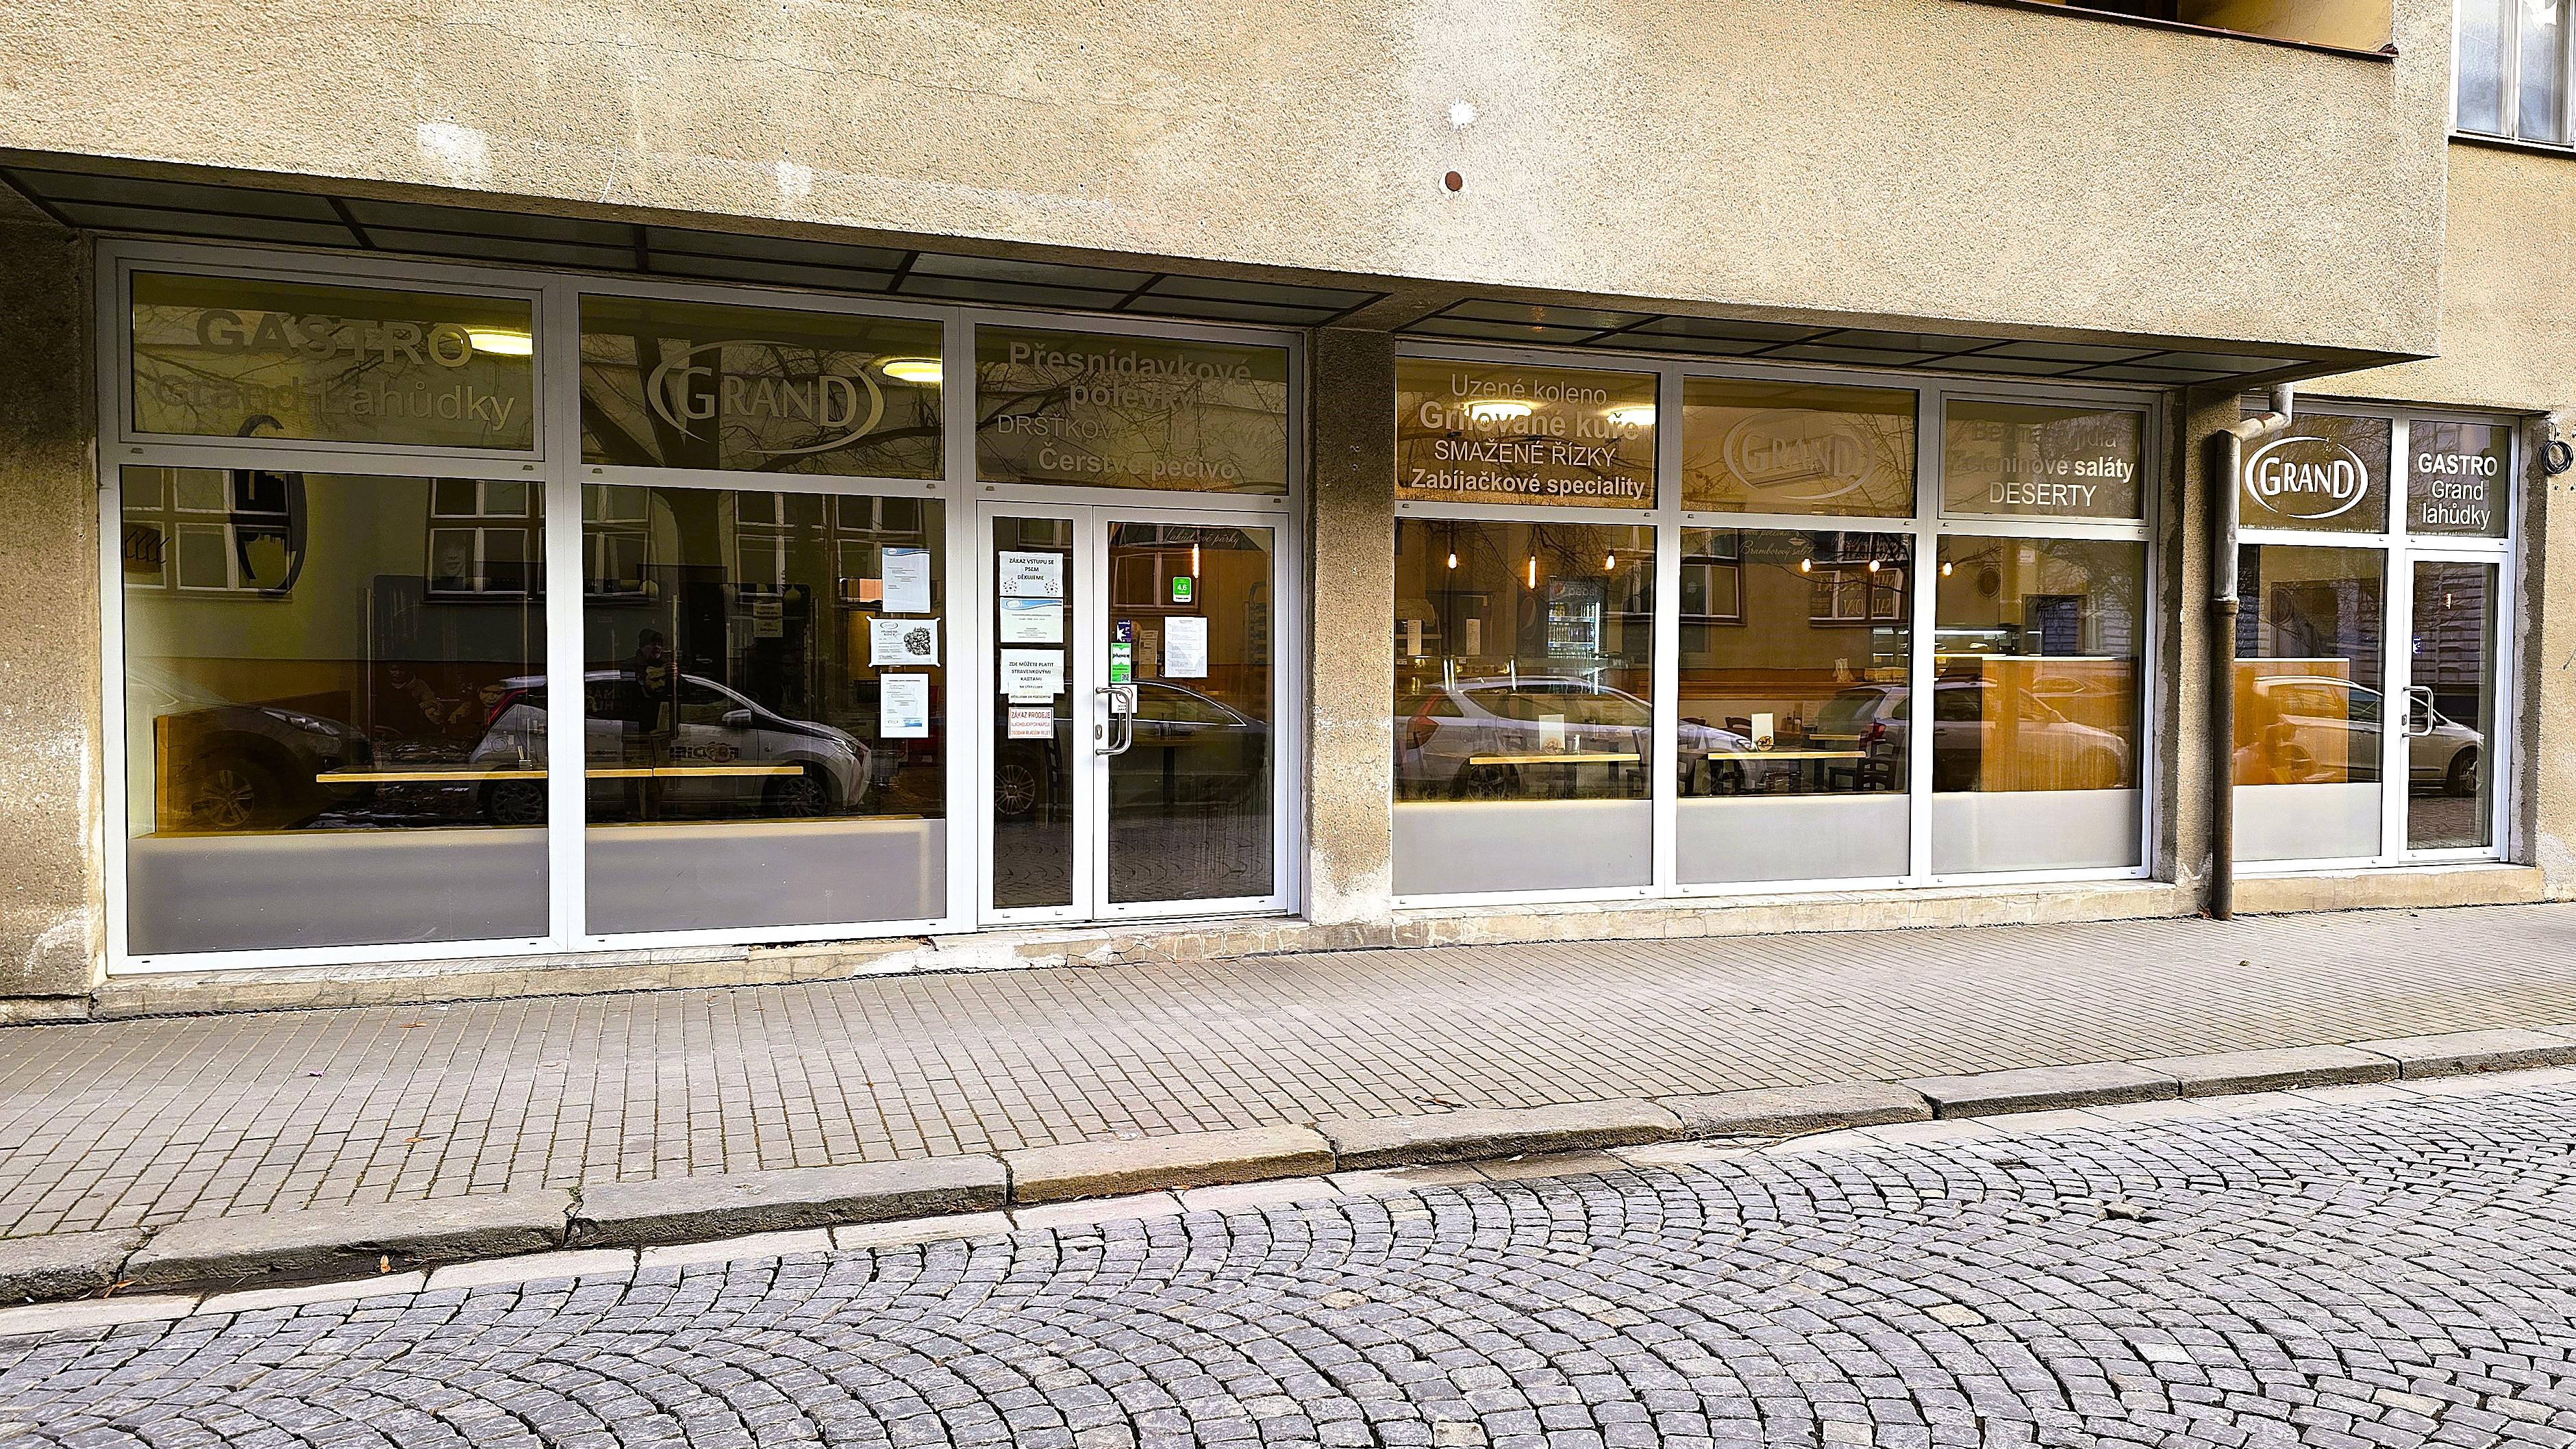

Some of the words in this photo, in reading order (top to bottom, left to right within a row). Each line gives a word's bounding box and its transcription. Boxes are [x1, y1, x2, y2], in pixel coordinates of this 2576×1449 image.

[197, 310, 473, 368] GASTRO
[1010, 342, 1252, 385] Přesnídavkové
[155, 377, 299, 413] Grand
[316, 379, 515, 431] Lahůdky
[677, 366, 858, 428] GRAND
[1070, 379, 1197, 412] polévky
[1451, 373, 1525, 399] Uzené
[1534, 378, 1608, 405] koleno
[1420, 401, 1566, 437] Grilované
[1576, 412, 1640, 441] kuře
[1038, 442, 1143, 475] Čerstvé
[1152, 455, 1235, 479] pečivo
[1435, 438, 1545, 464] SMAŽENÉ
[1552, 442, 1616, 467] ŘÍZKY
[2418, 452, 2499, 477] GASTRO
[1412, 468, 1540, 494] Zabíjačkové
[1547, 476, 1645, 500] speciality
[2074, 456, 2135, 483] saláty
[2260, 457, 2355, 499] GRAND
[1990, 481, 2097, 507] DESERTY
[2431, 479, 2484, 501] Grand
[2422, 503, 2492, 530] lahůdky
